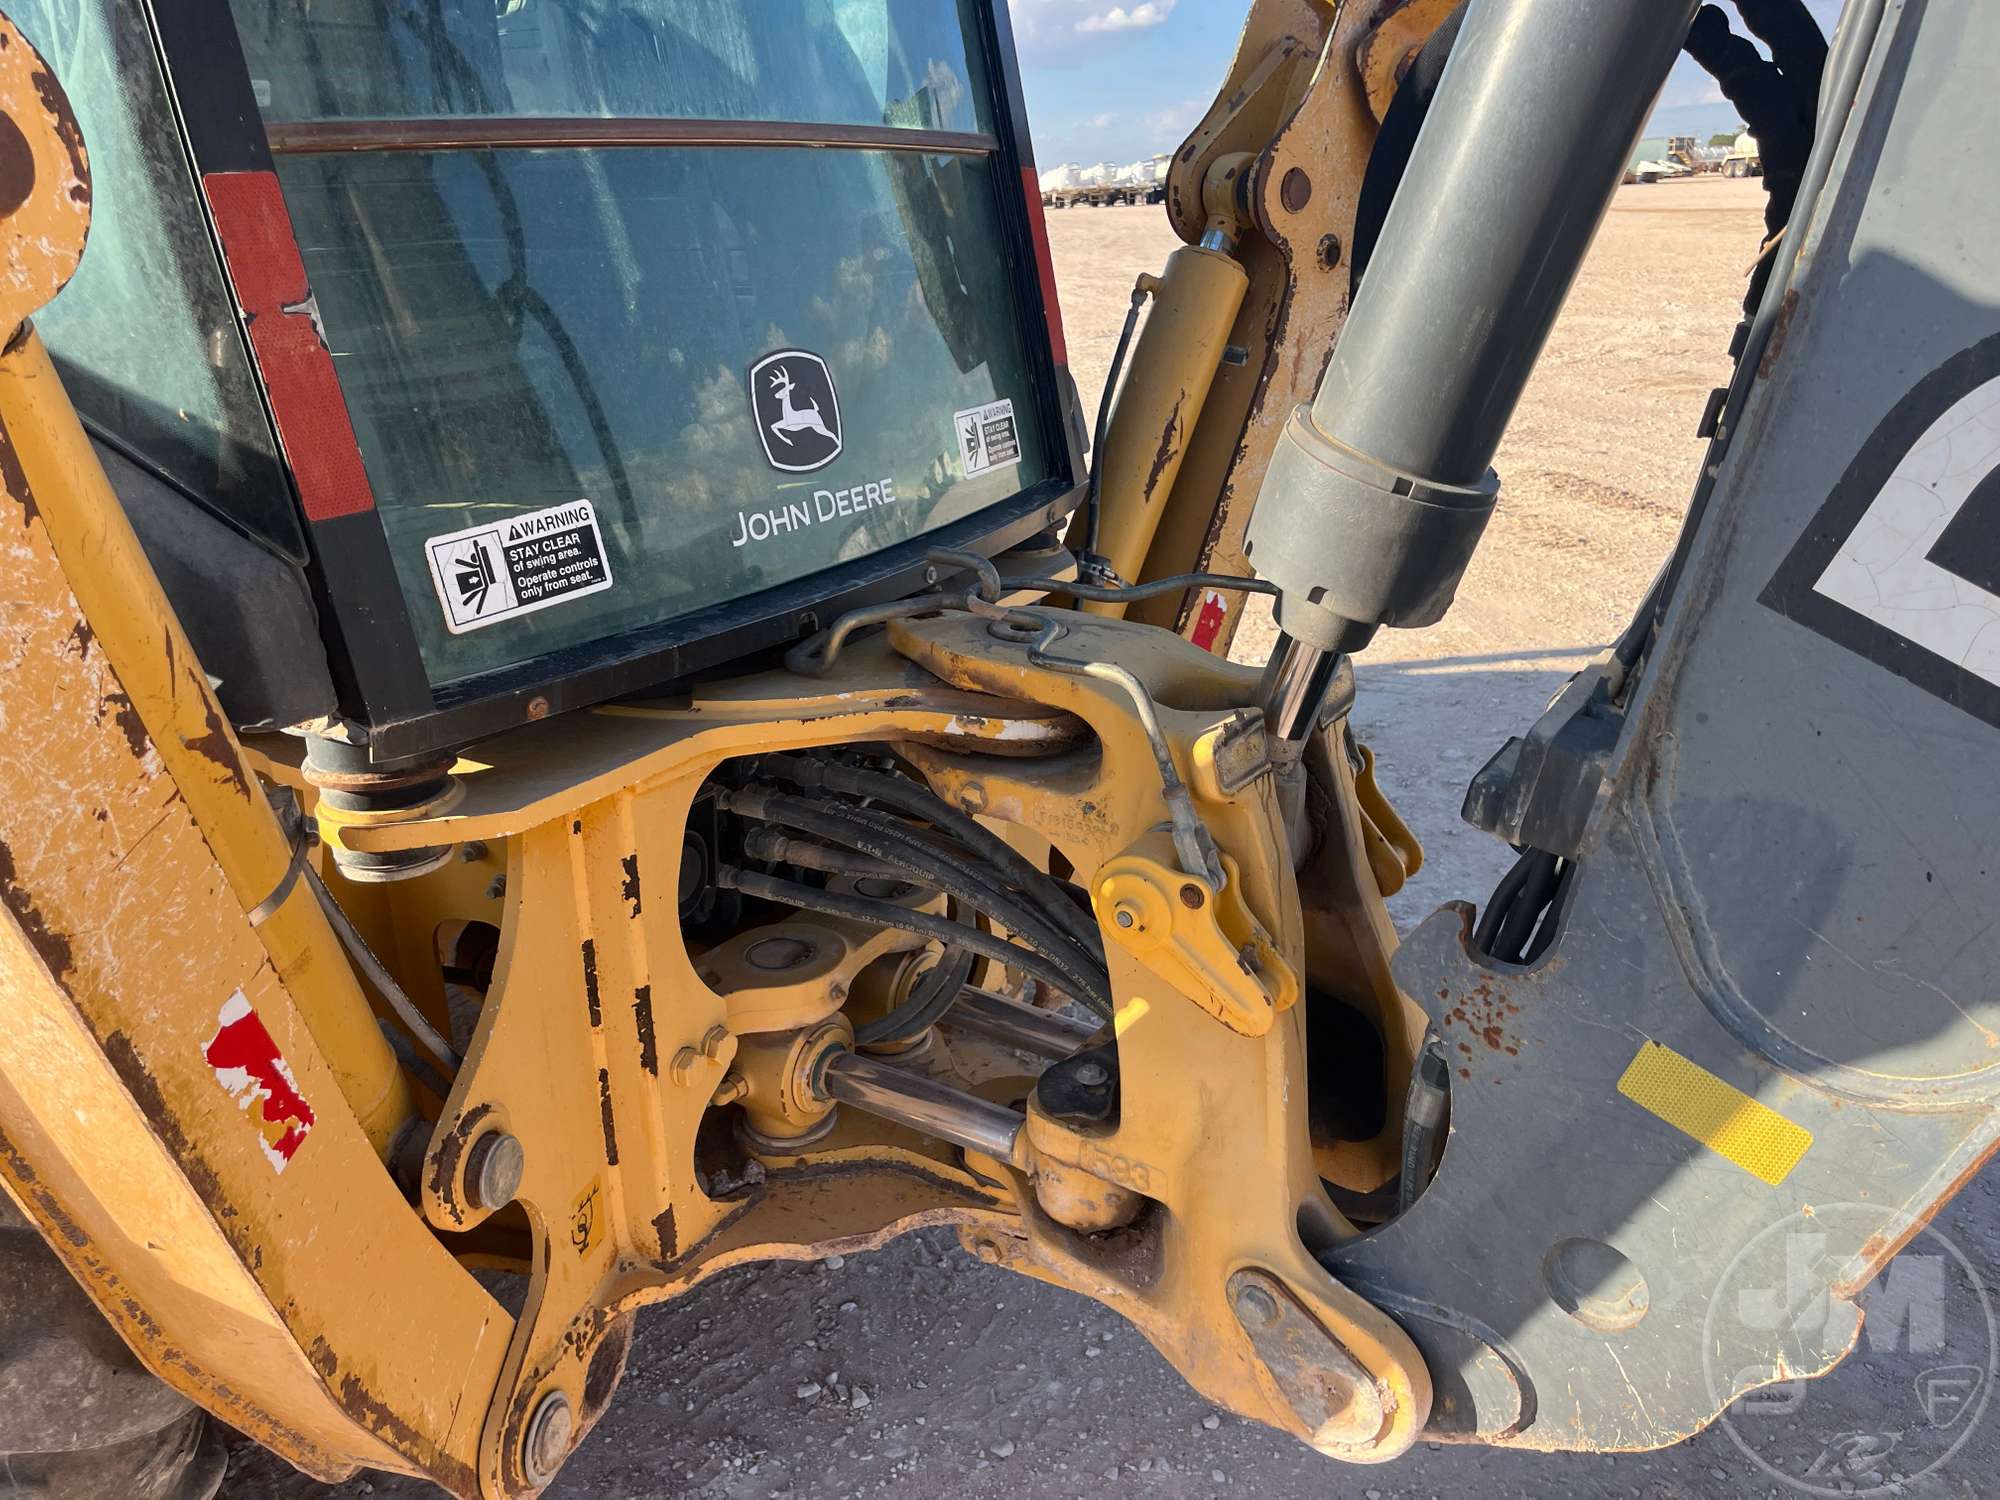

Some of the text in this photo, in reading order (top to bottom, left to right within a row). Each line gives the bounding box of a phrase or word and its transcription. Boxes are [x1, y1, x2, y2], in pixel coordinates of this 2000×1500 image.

[520, 506, 590, 536] WARNING
[732, 478, 896, 547] JOHN DEERE
[510, 533, 580, 562] STAY CLEAR
[513, 548, 582, 572] of swing area.
[518, 557, 598, 588] Operate controls
[521, 585, 542, 598] only
[544, 577, 568, 592] from
[570, 571, 593, 586] seat.
